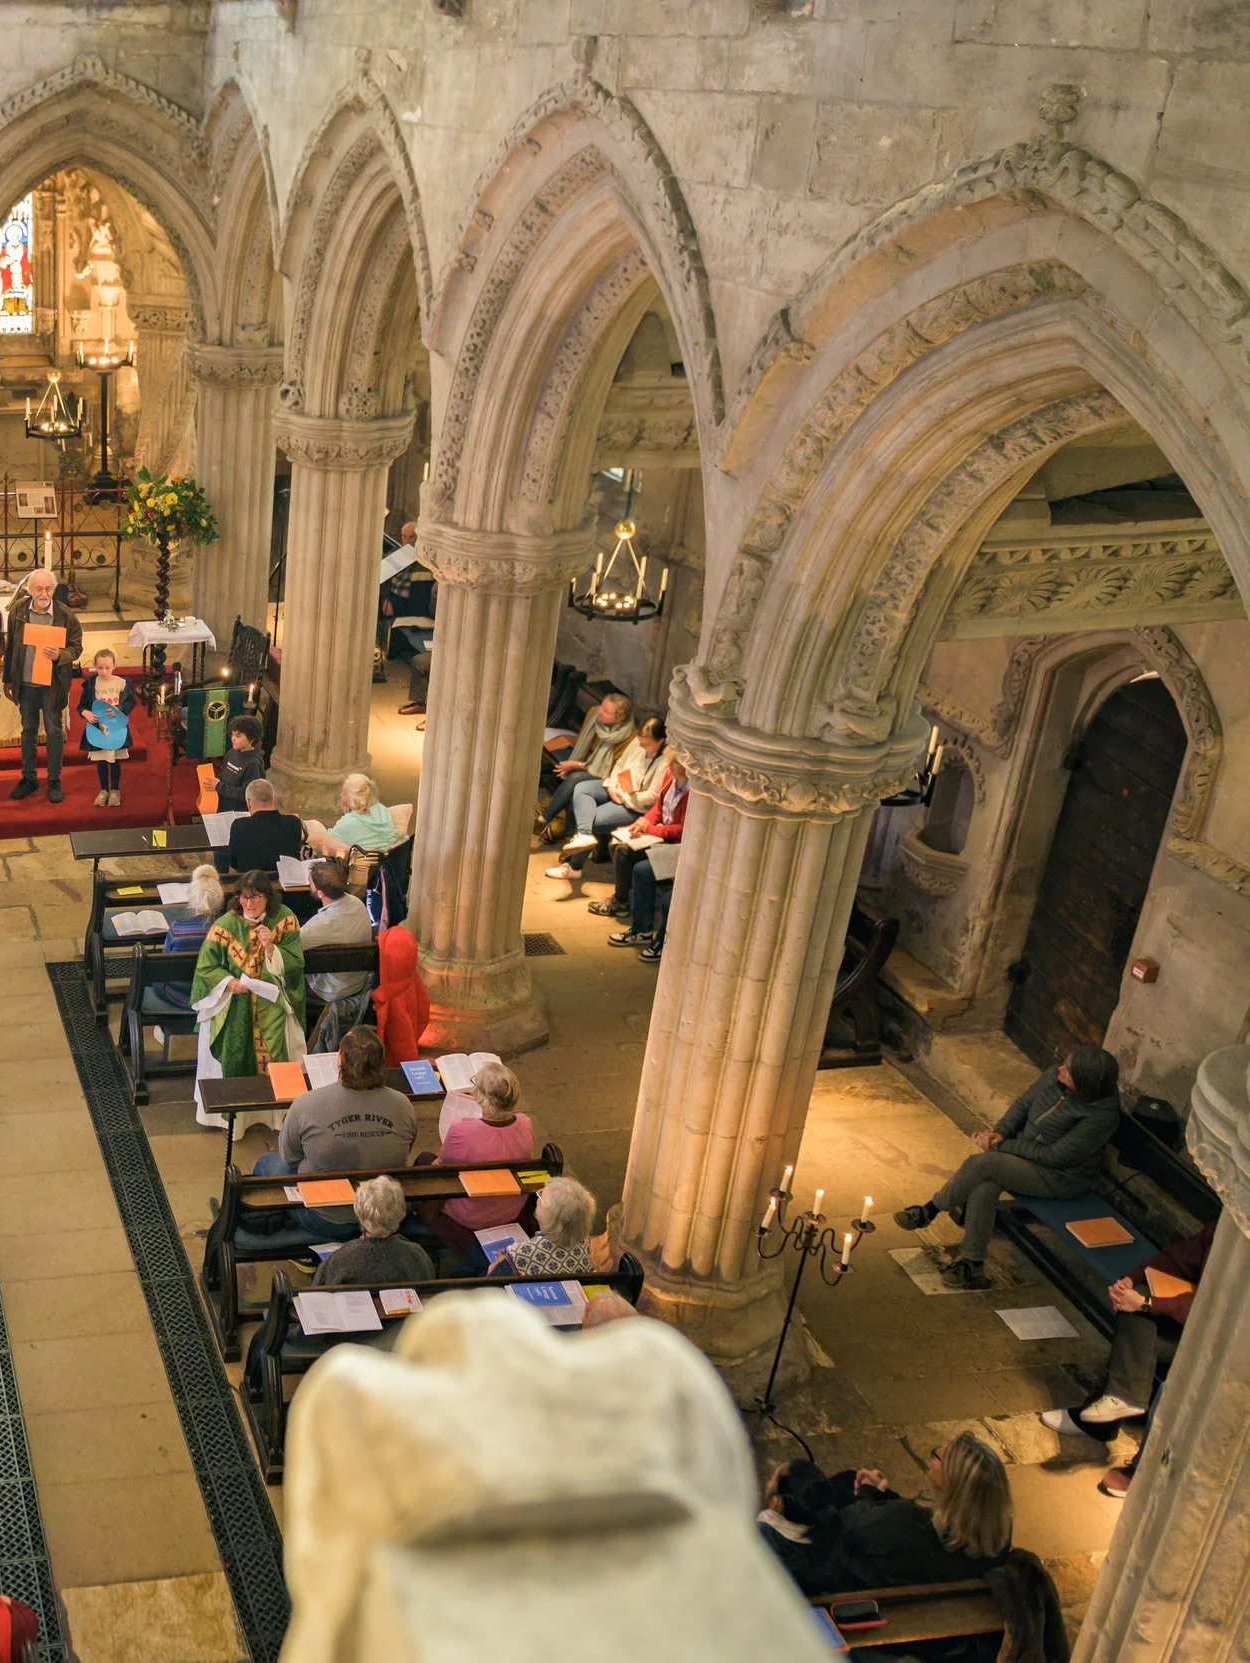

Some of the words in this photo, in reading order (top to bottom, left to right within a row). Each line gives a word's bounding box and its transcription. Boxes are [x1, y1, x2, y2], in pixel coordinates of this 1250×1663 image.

[327, 1113, 361, 1131] TYGER
[364, 1113, 394, 1129] RIVER
[359, 1130, 385, 1138] RESCUE
